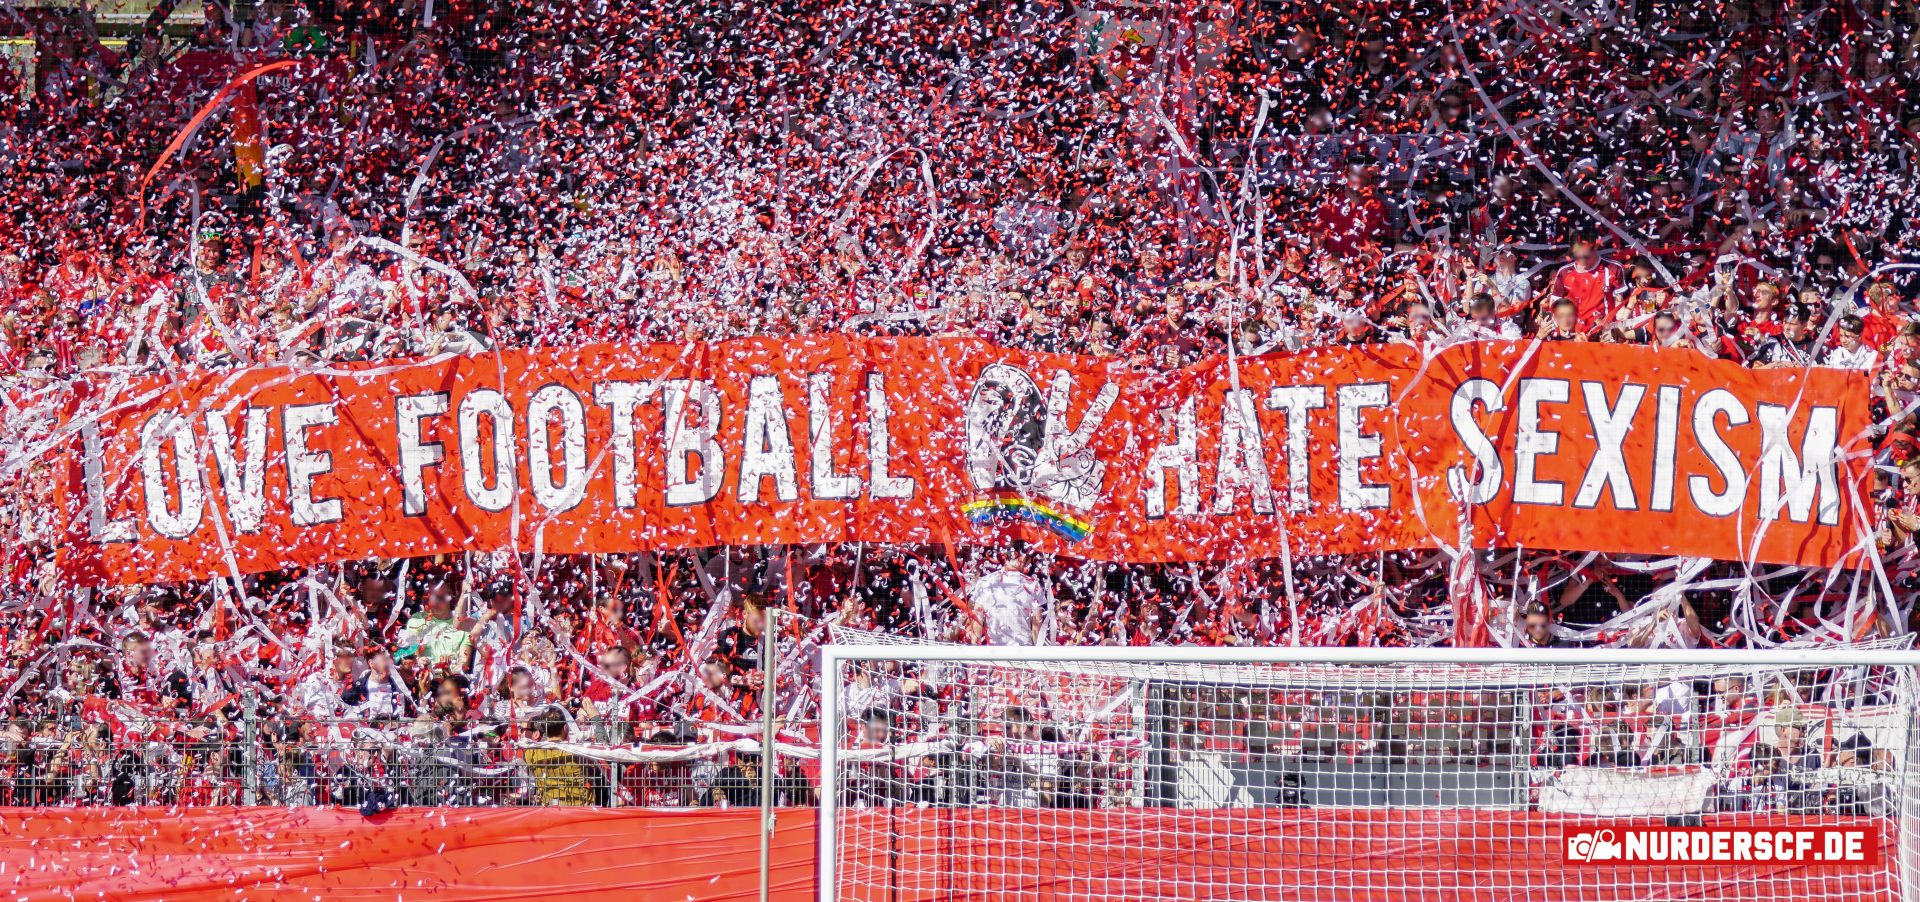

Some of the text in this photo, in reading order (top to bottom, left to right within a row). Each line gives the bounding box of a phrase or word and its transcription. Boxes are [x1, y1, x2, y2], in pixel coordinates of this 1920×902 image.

[80, 371, 1840, 544] LOVE FOOTBALL HATE SEXISM
